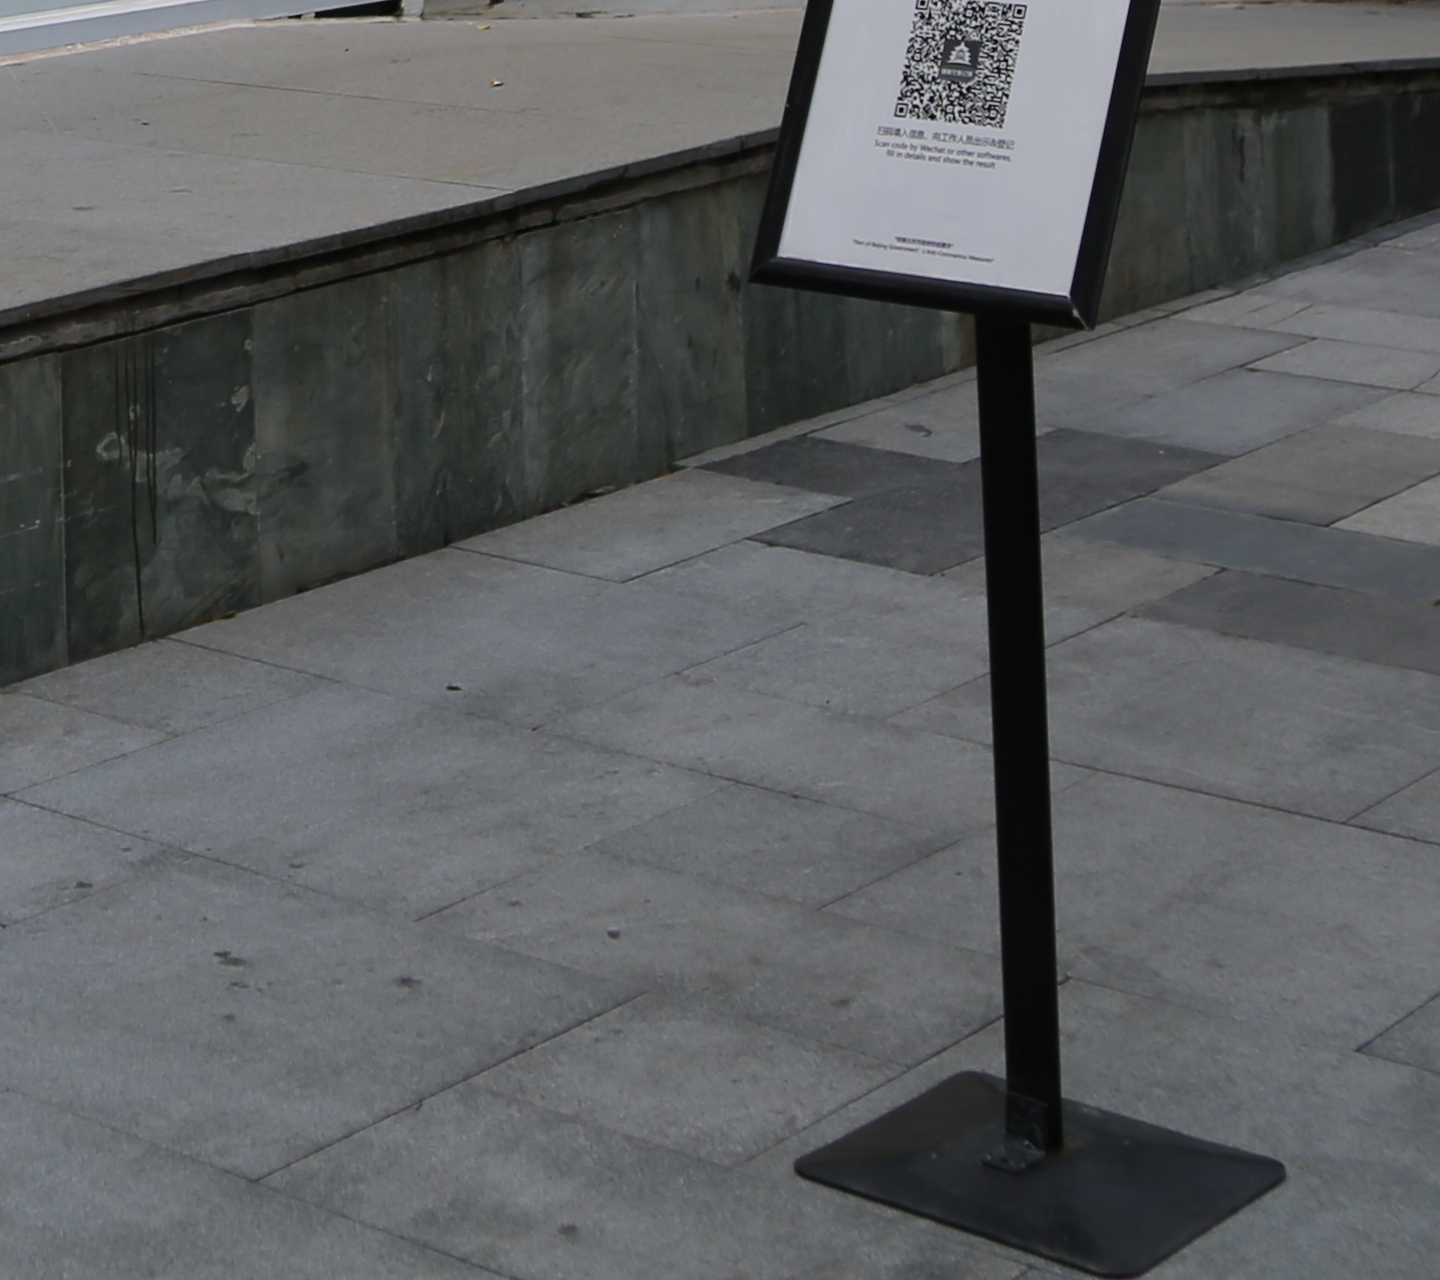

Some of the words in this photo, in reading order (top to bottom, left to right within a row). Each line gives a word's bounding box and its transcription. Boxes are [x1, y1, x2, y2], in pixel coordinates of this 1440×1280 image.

[874, 139, 890, 147] Scan
[891, 141, 908, 150] code
[909, 142, 919, 152] by
[956, 147, 975, 157] other
[904, 152, 926, 161] details
[927, 155, 941, 163] and
[942, 156, 961, 165] show
[962, 158, 974, 167] the
[975, 160, 996, 169] result
